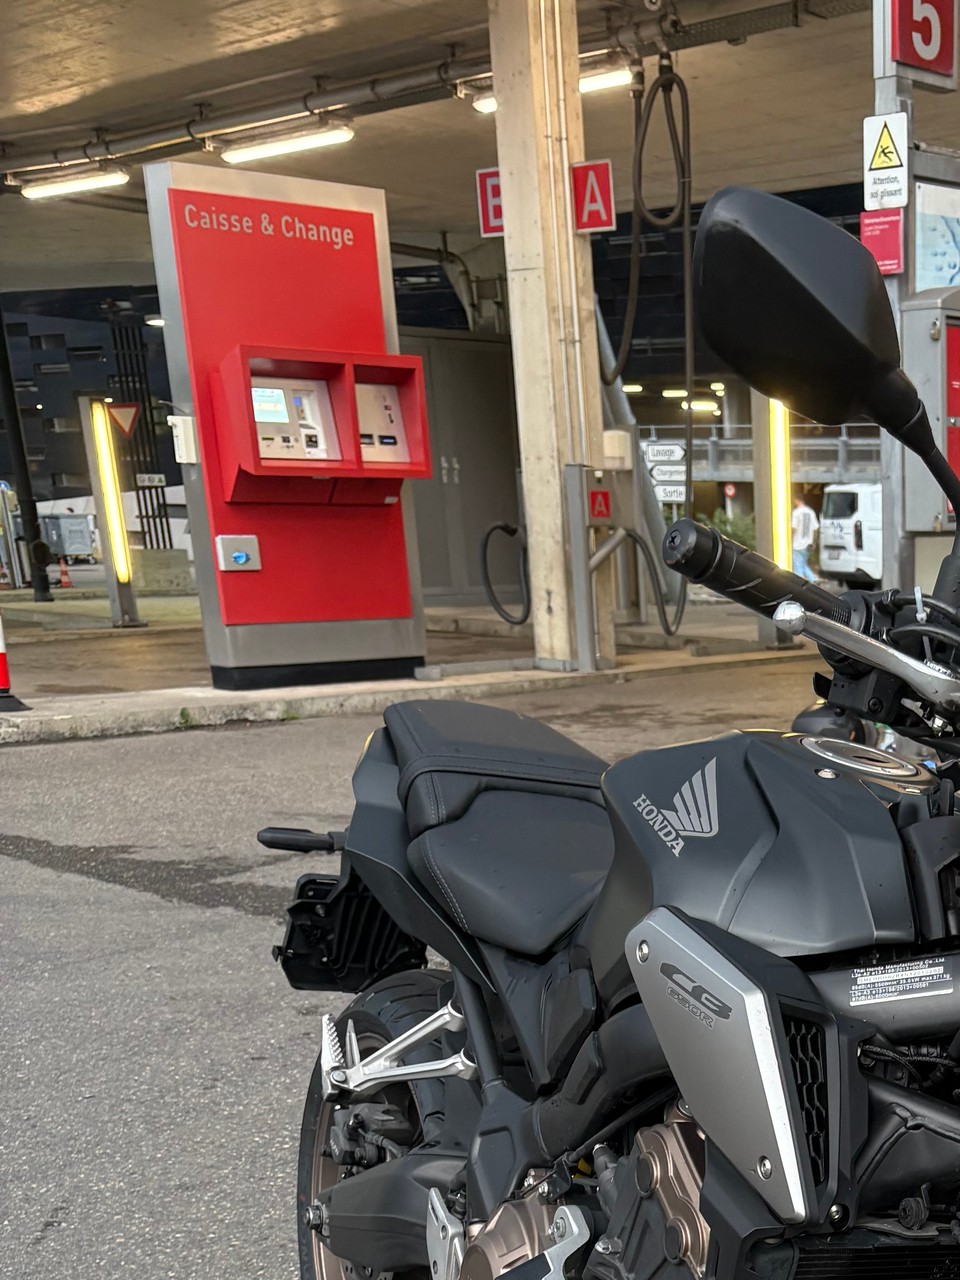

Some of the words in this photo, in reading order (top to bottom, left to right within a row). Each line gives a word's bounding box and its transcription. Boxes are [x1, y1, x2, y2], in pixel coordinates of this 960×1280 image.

[912, 0, 941, 61] 5
[582, 170, 607, 222] A
[184, 204, 253, 233] Caisse
[260, 213, 274, 236] &
[281, 215, 354, 250] Change
[594, 494, 608, 516] A
[632, 794, 684, 857] HONDA
[660, 962, 732, 1020] CB
[666, 986, 714, 1028] 650R
